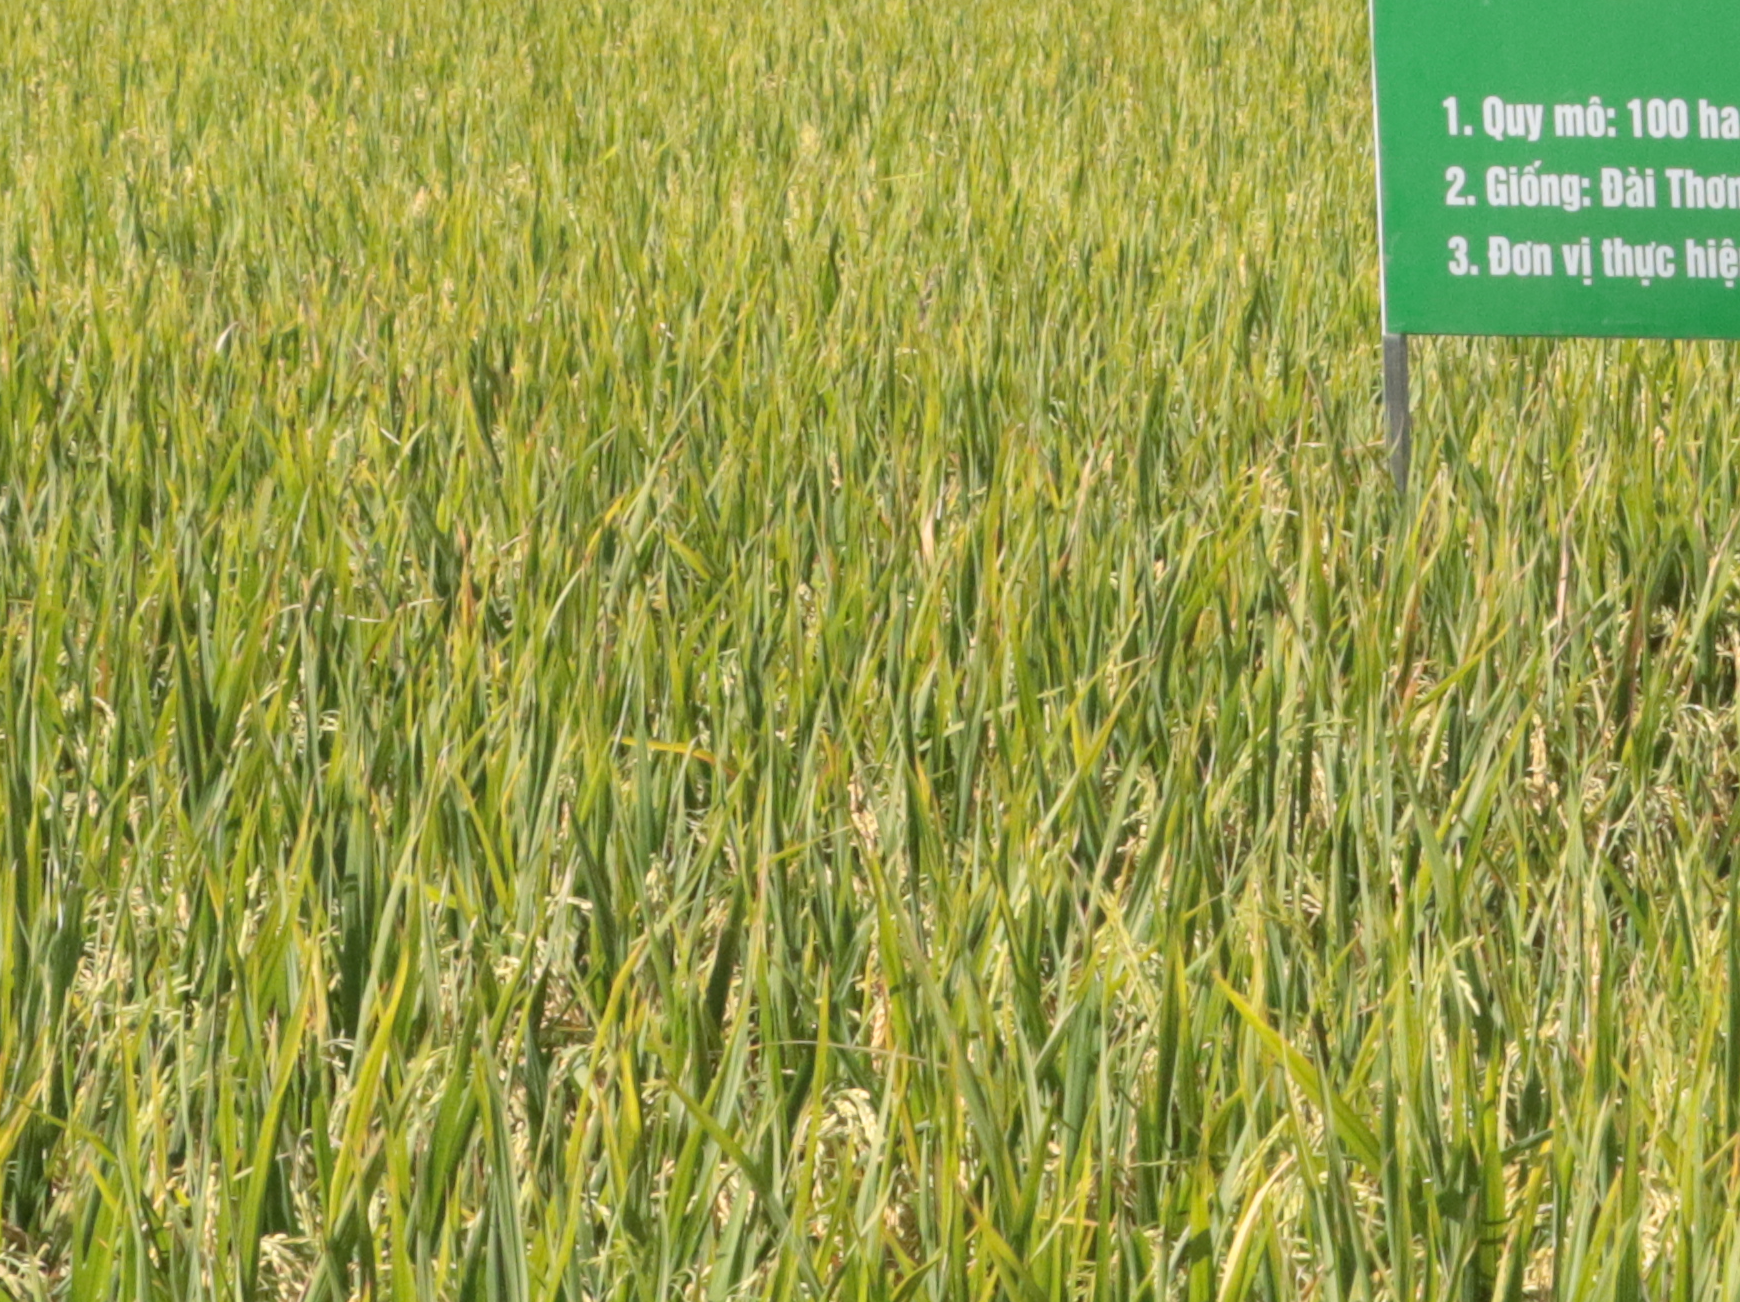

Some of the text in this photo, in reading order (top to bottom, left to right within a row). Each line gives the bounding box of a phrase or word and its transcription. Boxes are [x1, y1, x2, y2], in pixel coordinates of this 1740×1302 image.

[1443, 97, 1472, 135] 1.
[1483, 96, 1543, 141] Quy
[1554, 96, 1615, 137] mô:
[1627, 99, 1689, 138] 100
[1446, 166, 1475, 205] 2.
[1486, 161, 1590, 211] Giống:
[1600, 168, 1655, 207] Đài
[1448, 236, 1478, 275] 3.
[1488, 236, 1552, 276] Đơn
[1562, 238, 1591, 284] vị
[1602, 238, 1675, 285] thực
